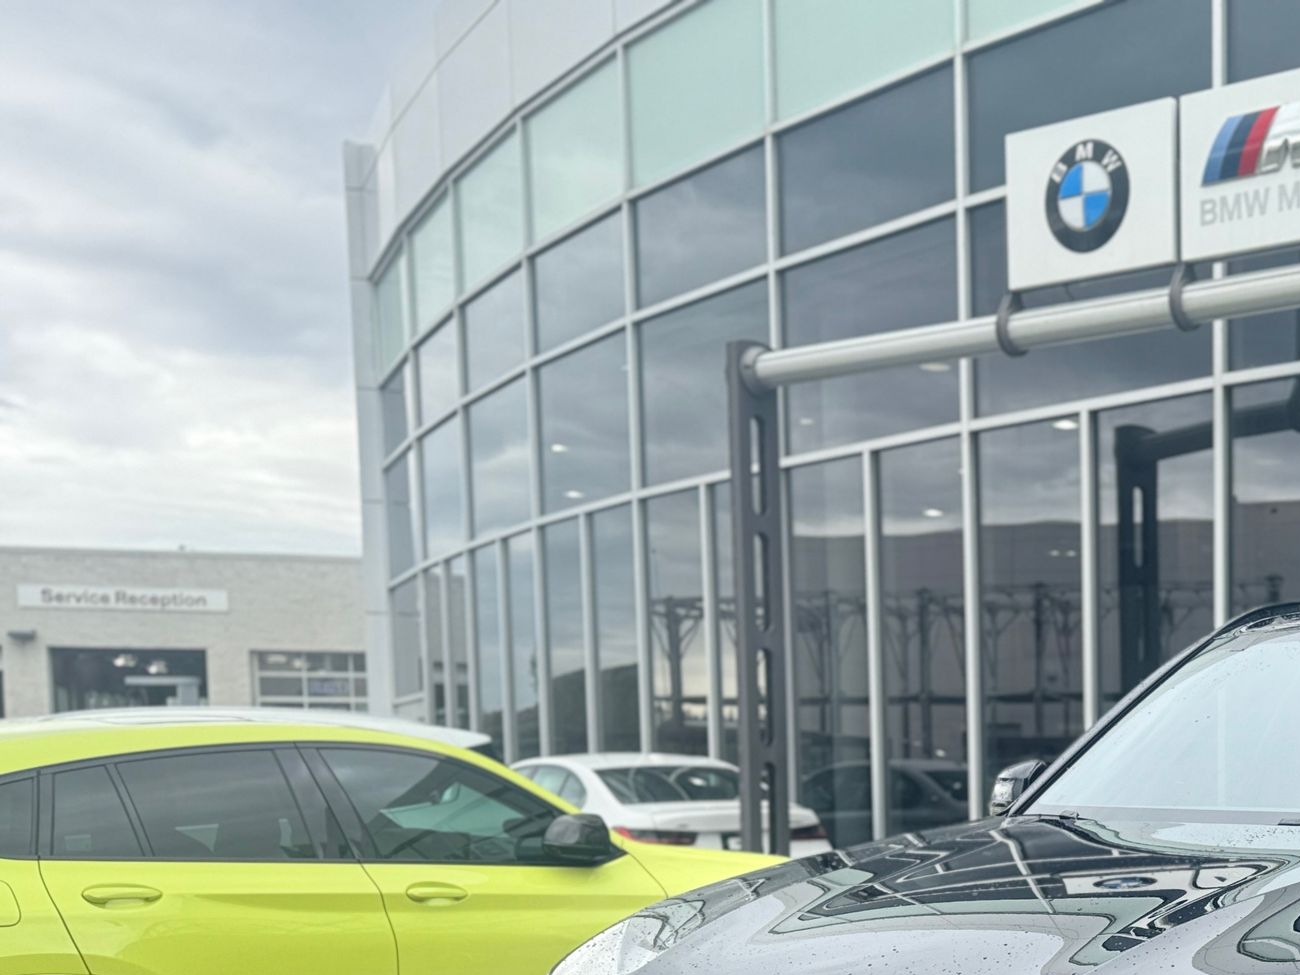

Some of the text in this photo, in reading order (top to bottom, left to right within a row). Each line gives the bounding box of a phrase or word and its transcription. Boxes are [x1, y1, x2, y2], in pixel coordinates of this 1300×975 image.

[1200, 187, 1269, 226] BMW
[41, 588, 207, 608] Service Reception
